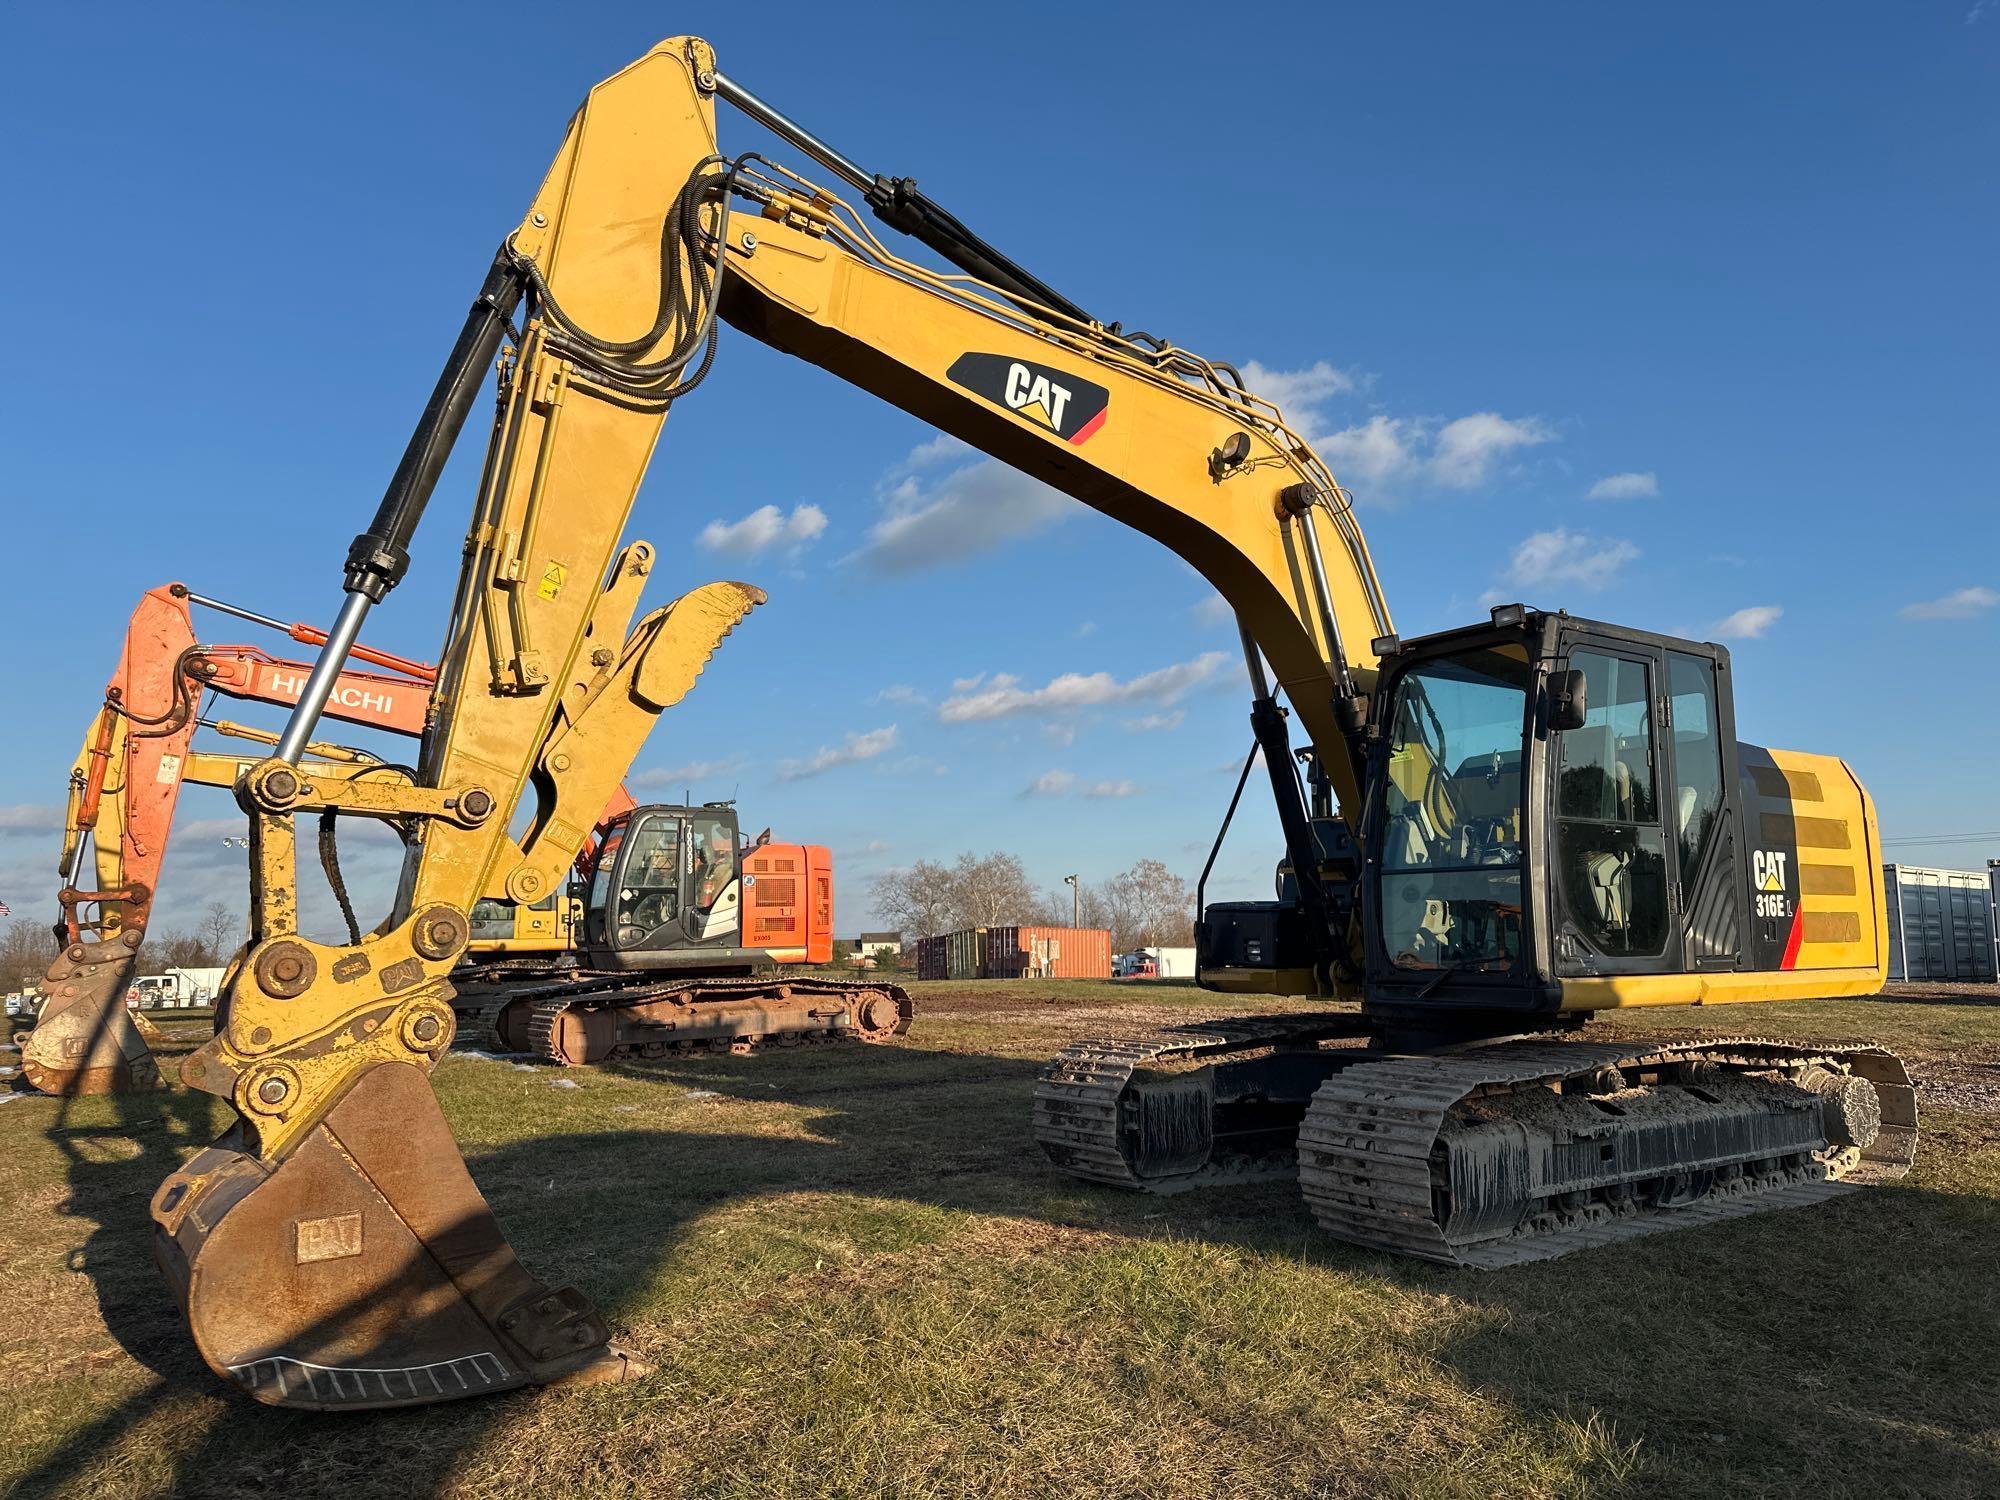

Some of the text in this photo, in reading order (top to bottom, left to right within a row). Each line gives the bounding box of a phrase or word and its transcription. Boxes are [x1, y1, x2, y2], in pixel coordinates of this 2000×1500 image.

[1004, 362, 1072, 432] CAT
[271, 673, 393, 714] HIACHI
[1753, 849, 1786, 891] CAT
[1755, 893, 1785, 917] 316E
